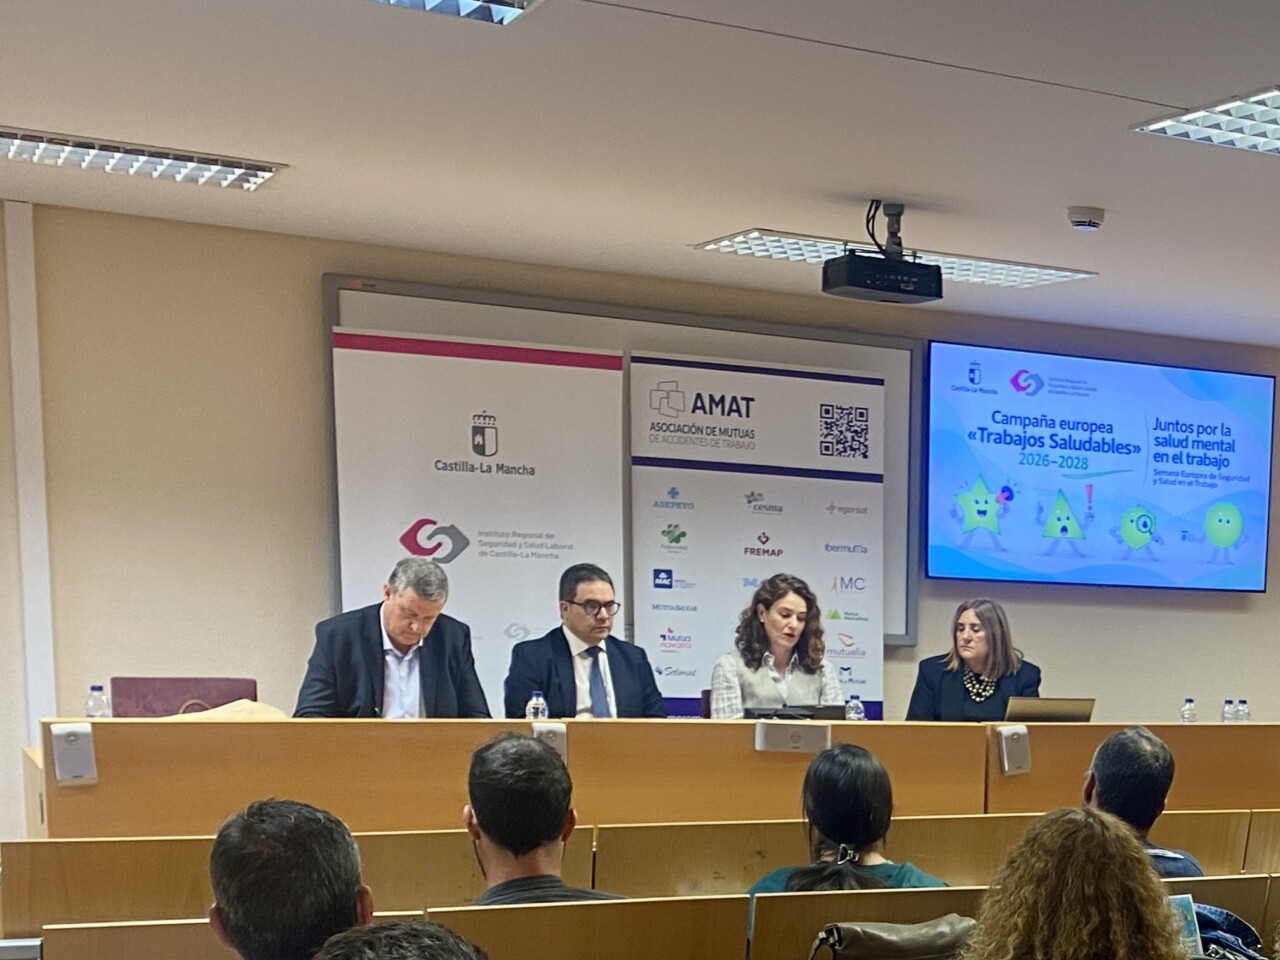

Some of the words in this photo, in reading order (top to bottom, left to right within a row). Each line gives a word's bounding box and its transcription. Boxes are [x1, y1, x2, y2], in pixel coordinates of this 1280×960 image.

[691, 392, 756, 419] AMAT
[650, 421, 704, 436] ASOCIACIÓN
[705, 425, 717, 437] DE
[718, 427, 755, 440] MUTUAS
[991, 410, 1056, 430] Campaña
[1059, 419, 1113, 435] europea
[1152, 417, 1194, 434] Juntos
[1196, 424, 1218, 437] por
[1220, 422, 1232, 437] la
[649, 433, 659, 444] DE
[660, 434, 710, 447] ACCIDENTES
[710, 437, 722, 448] DE
[722, 439, 756, 450] TRABAJO
[967, 427, 1045, 450] «Trabajos
[1049, 433, 1142, 455] Saludables»
[1154, 434, 1189, 449] salud
[1191, 439, 1236, 453] mental
[434, 460, 492, 474] Castilla-La
[495, 463, 536, 476] Mancha
[1153, 452, 1169, 463] en
[1171, 451, 1183, 464] el
[1186, 452, 1230, 471] trabajo
[1152, 478, 1157, 486] y
[1158, 478, 1178, 486] Salud
[1187, 479, 1194, 487] el
[1194, 480, 1218, 489] Trabajo
[1153, 469, 1179, 478] Semana
[1181, 470, 1208, 480] Europea
[1208, 472, 1217, 480] de
[1218, 473, 1250, 483] Seguridad
[753, 503, 783, 513] cesma
[511, 531, 544, 541] Regional
[545, 532, 555, 540] de
[478, 540, 517, 549] Seguridad
[523, 541, 544, 549] Salud
[545, 542, 573, 550] Laboral
[744, 547, 784, 557] FREMAP
[840, 576, 866, 591] MC
[827, 647, 866, 657] mutualia
